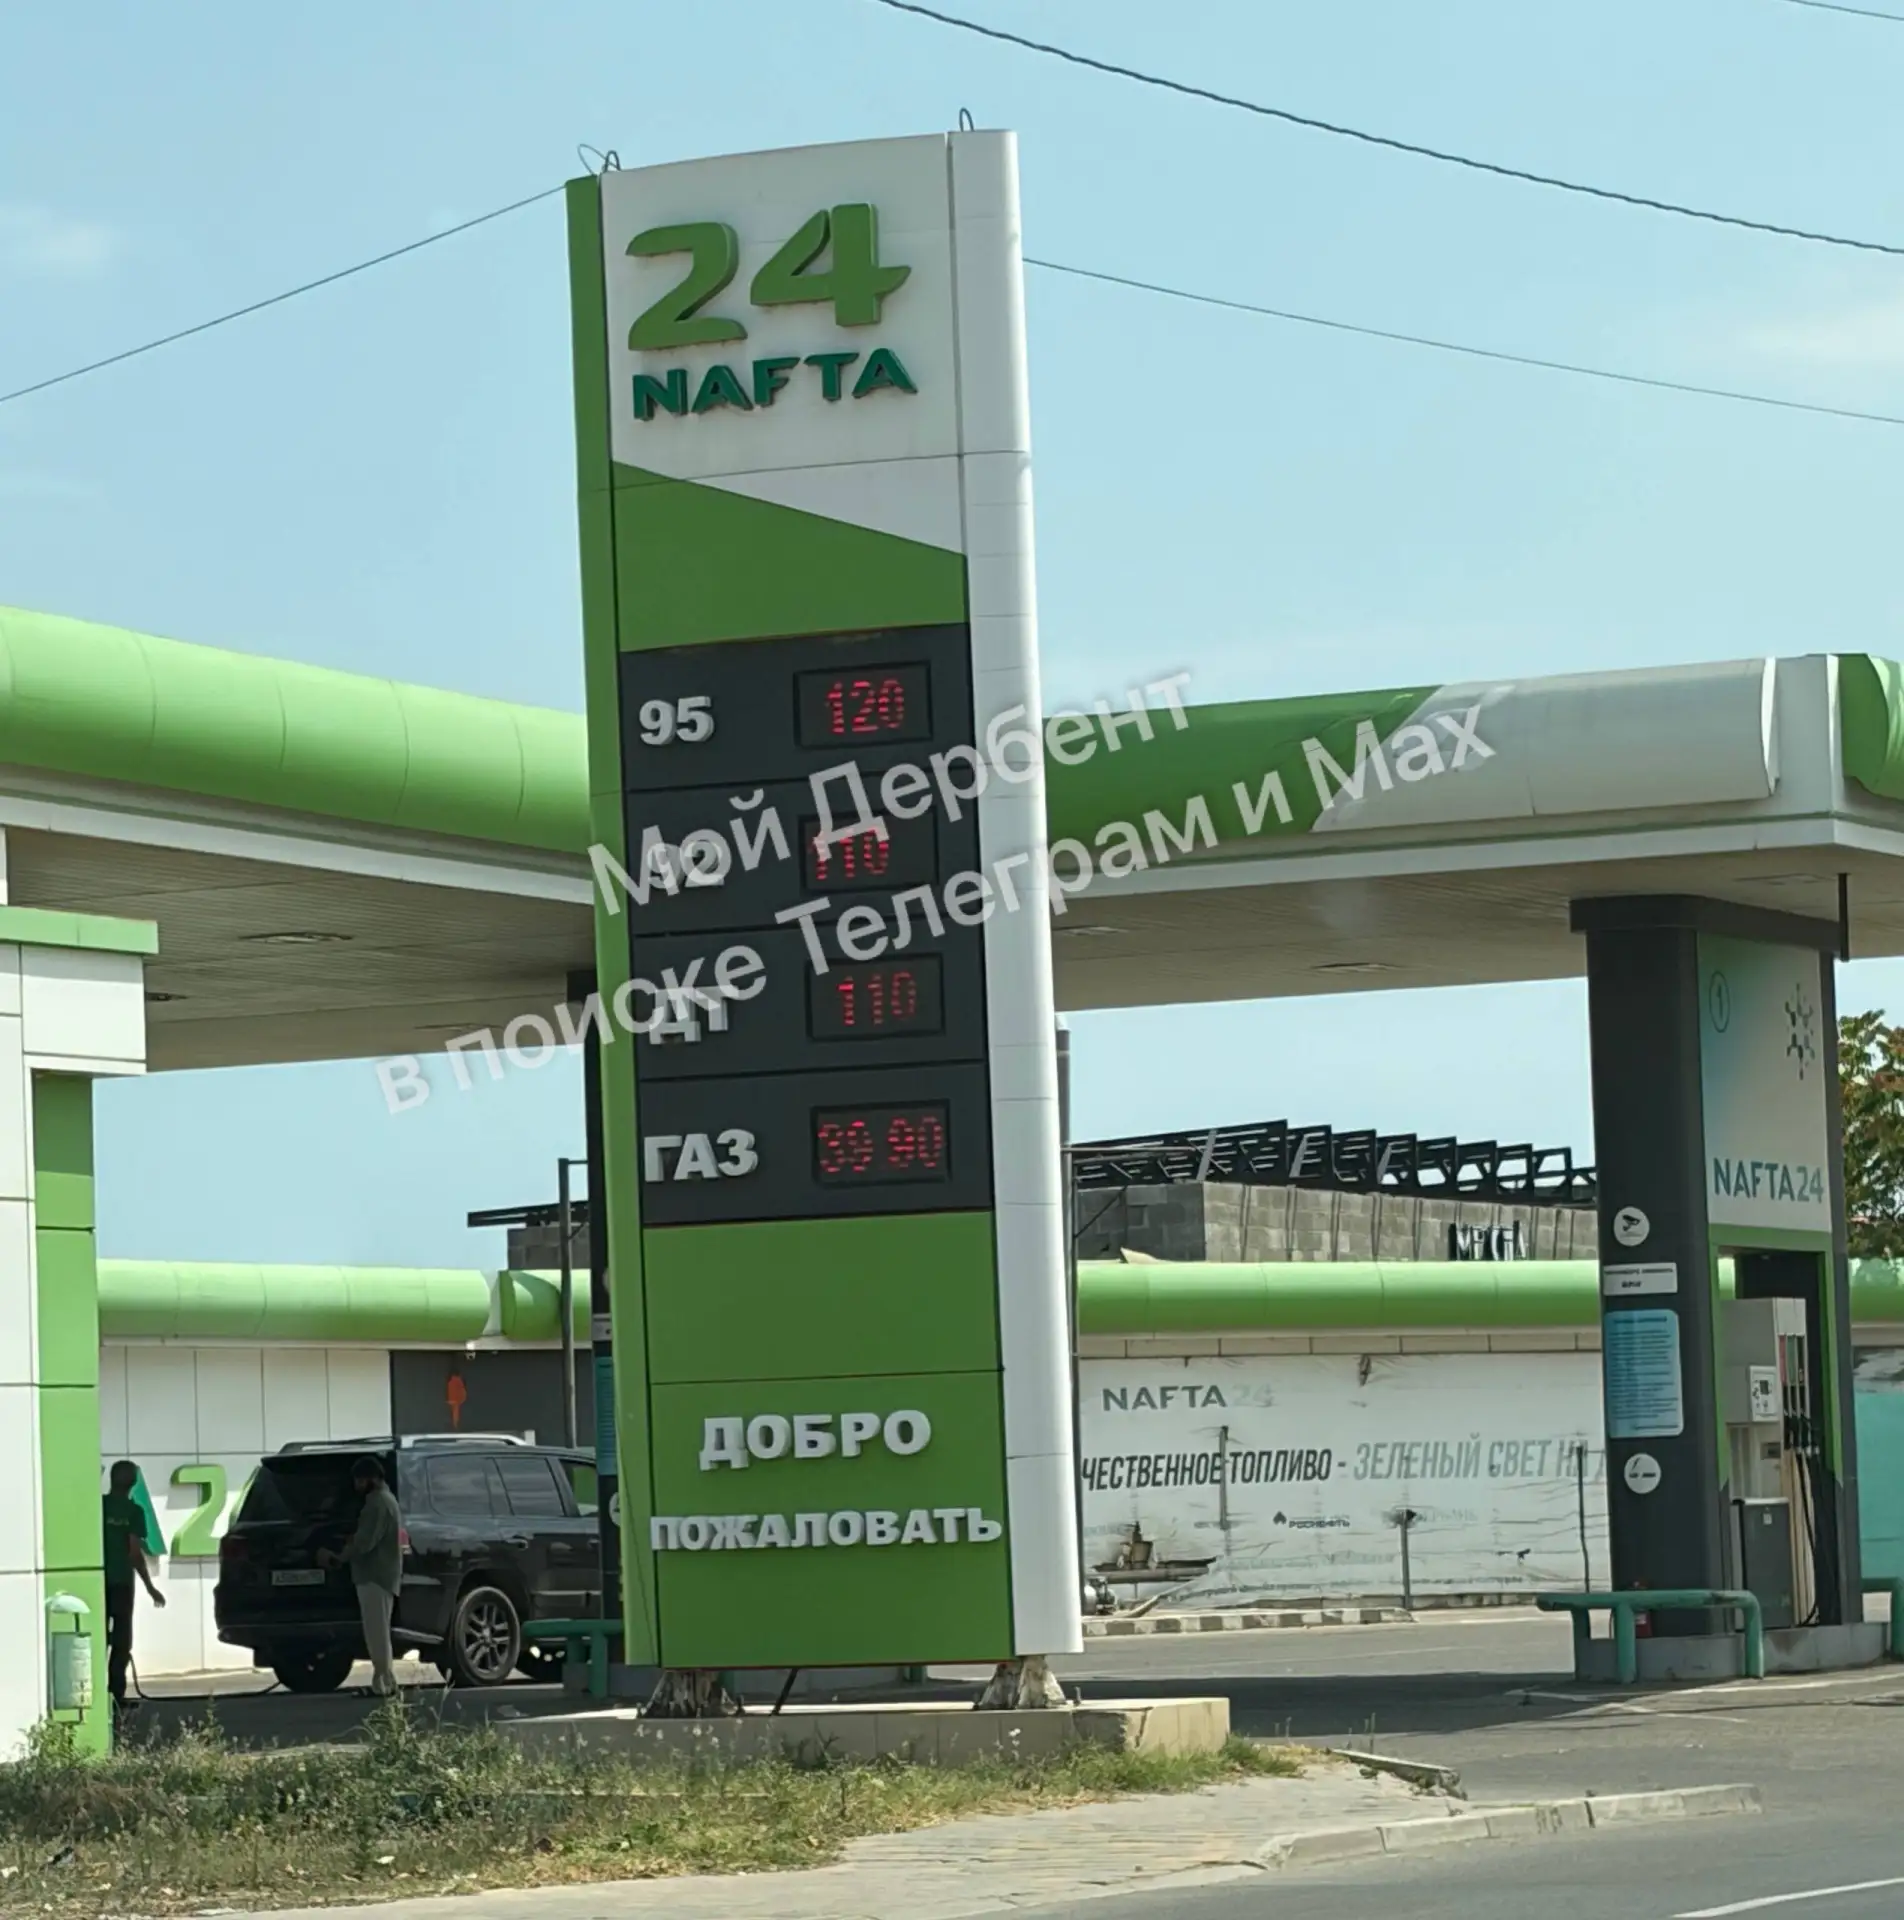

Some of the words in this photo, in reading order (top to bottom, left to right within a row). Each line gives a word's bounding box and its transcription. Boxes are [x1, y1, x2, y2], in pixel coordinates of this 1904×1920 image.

[625, 203, 912, 350] 24
[632, 348, 918, 421] NAFTA
[639, 696, 714, 745] 95
[826, 679, 904, 734] 120
[647, 839, 725, 889] 92
[649, 985, 729, 1045] ДТ
[836, 971, 917, 1026] 110
[644, 1128, 759, 1183] ГАЗ
[1712, 1157, 1824, 1204] NAFTA24
[699, 1409, 932, 1471] ДОБРО
[1081, 1453, 1222, 1491] ЧЕСТВЕННОЕ
[1229, 1449, 1333, 1485] ТОПЛИВО
[1354, 1432, 1482, 1480] ЗЕЛЕНЫЙ
[1488, 1440, 1552, 1478] СВЕТ
[650, 1507, 1002, 1551] ПОЖАЛОВАТЬ
